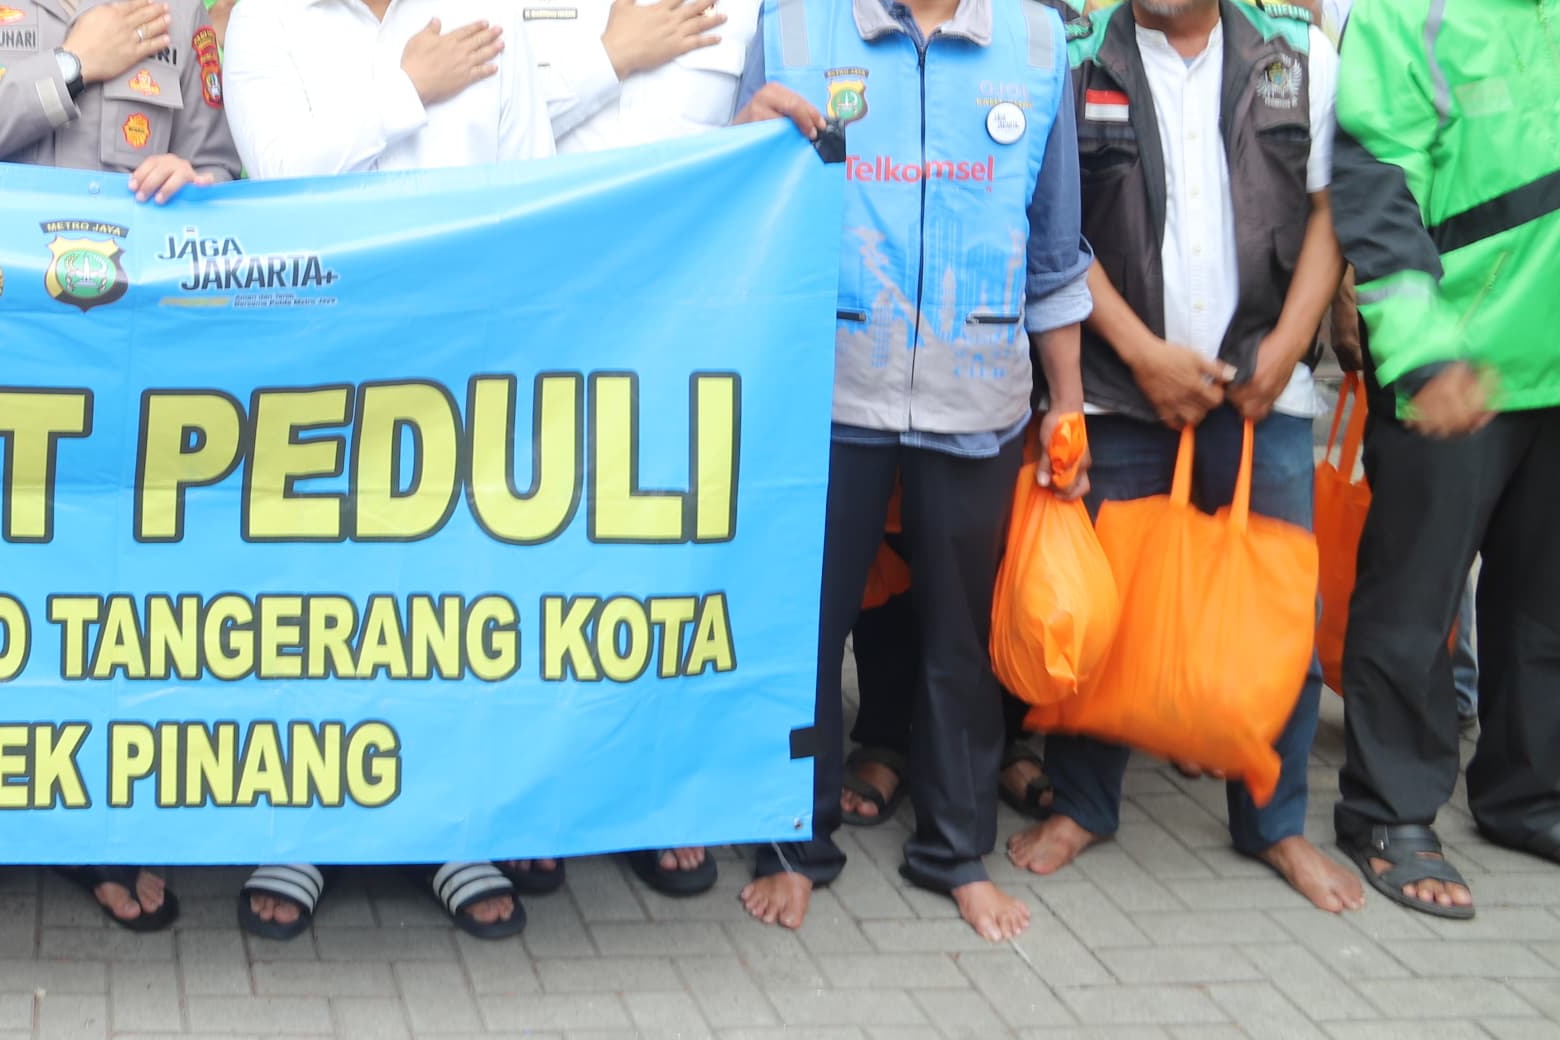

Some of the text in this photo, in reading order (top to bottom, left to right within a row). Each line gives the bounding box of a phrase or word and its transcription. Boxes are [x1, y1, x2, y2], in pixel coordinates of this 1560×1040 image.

[845, 154, 995, 184] Telkomsel
[47, 222, 121, 236] METRO JAYA
[158, 235, 243, 260] JAGA
[134, 371, 740, 545] PEDULI
[47, 592, 522, 682] TANGERANG
[538, 590, 737, 682] KOTA
[107, 720, 402, 809] PINANG
